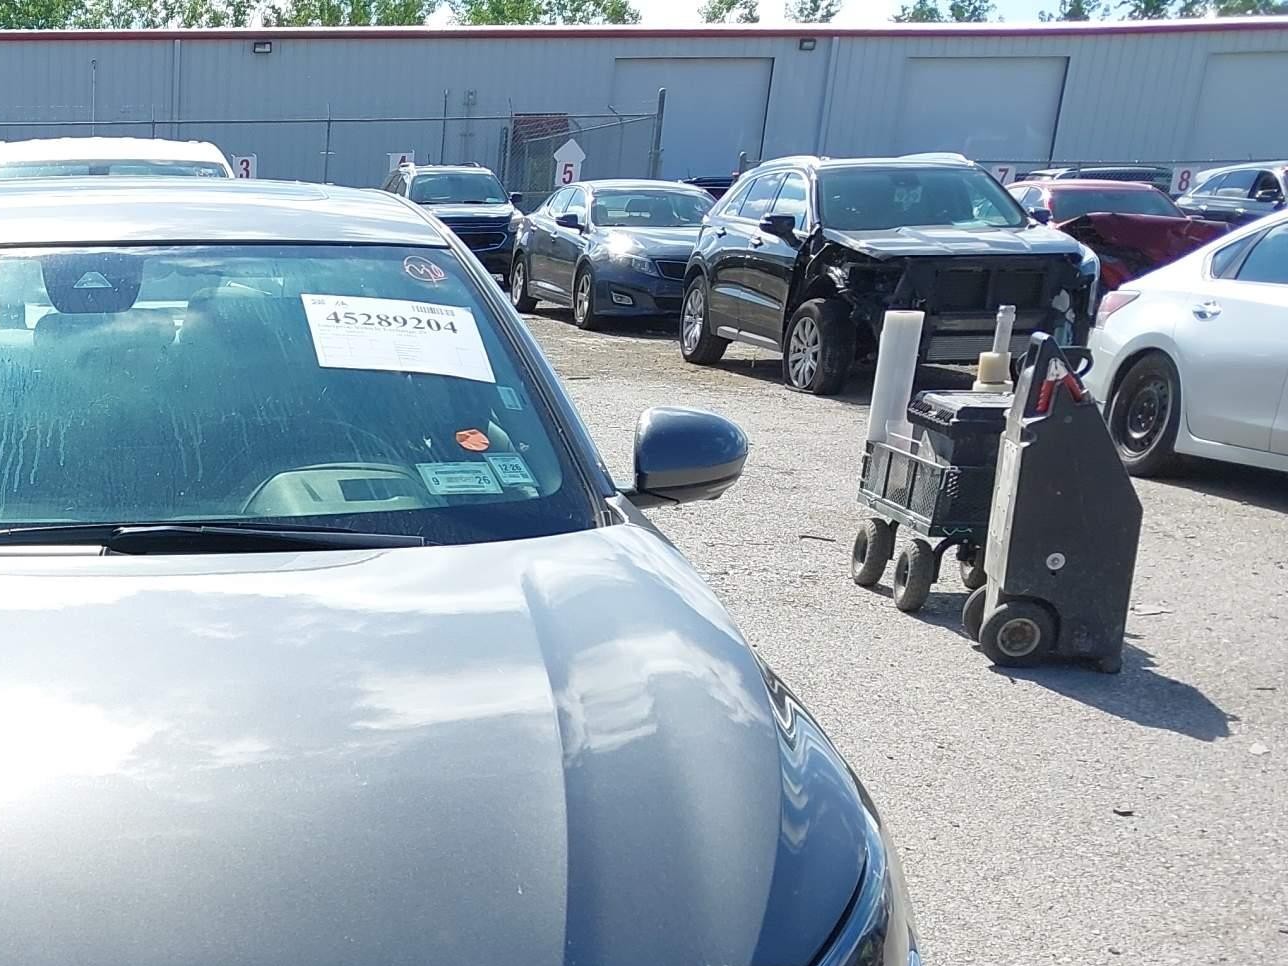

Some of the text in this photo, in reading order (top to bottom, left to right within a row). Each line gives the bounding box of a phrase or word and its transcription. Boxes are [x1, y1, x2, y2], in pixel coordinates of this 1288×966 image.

[239, 158, 251, 179] 3
[562, 163, 574, 184] 5
[997, 168, 1010, 186] 7
[1177, 170, 1191, 191] 8
[326, 311, 458, 334] 45289204
[475, 476, 491, 485] 26
